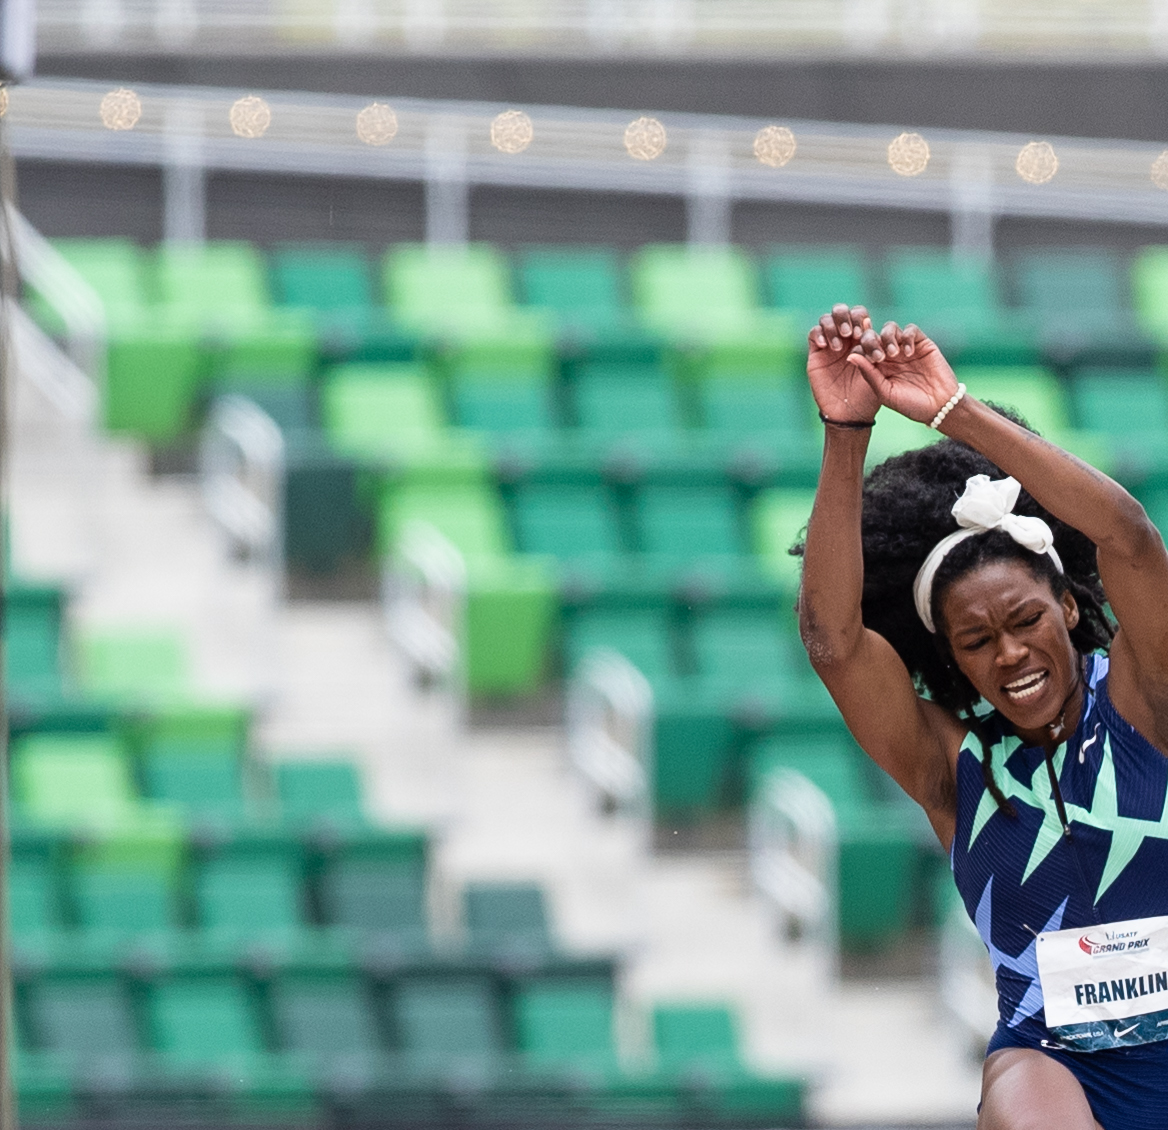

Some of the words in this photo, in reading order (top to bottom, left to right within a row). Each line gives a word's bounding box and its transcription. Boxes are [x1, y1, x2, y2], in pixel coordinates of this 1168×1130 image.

[1093, 943, 1126, 955] GRAND
[1127, 938, 1150, 950] PRIX
[1074, 971, 1168, 1006] FRANKLIN
